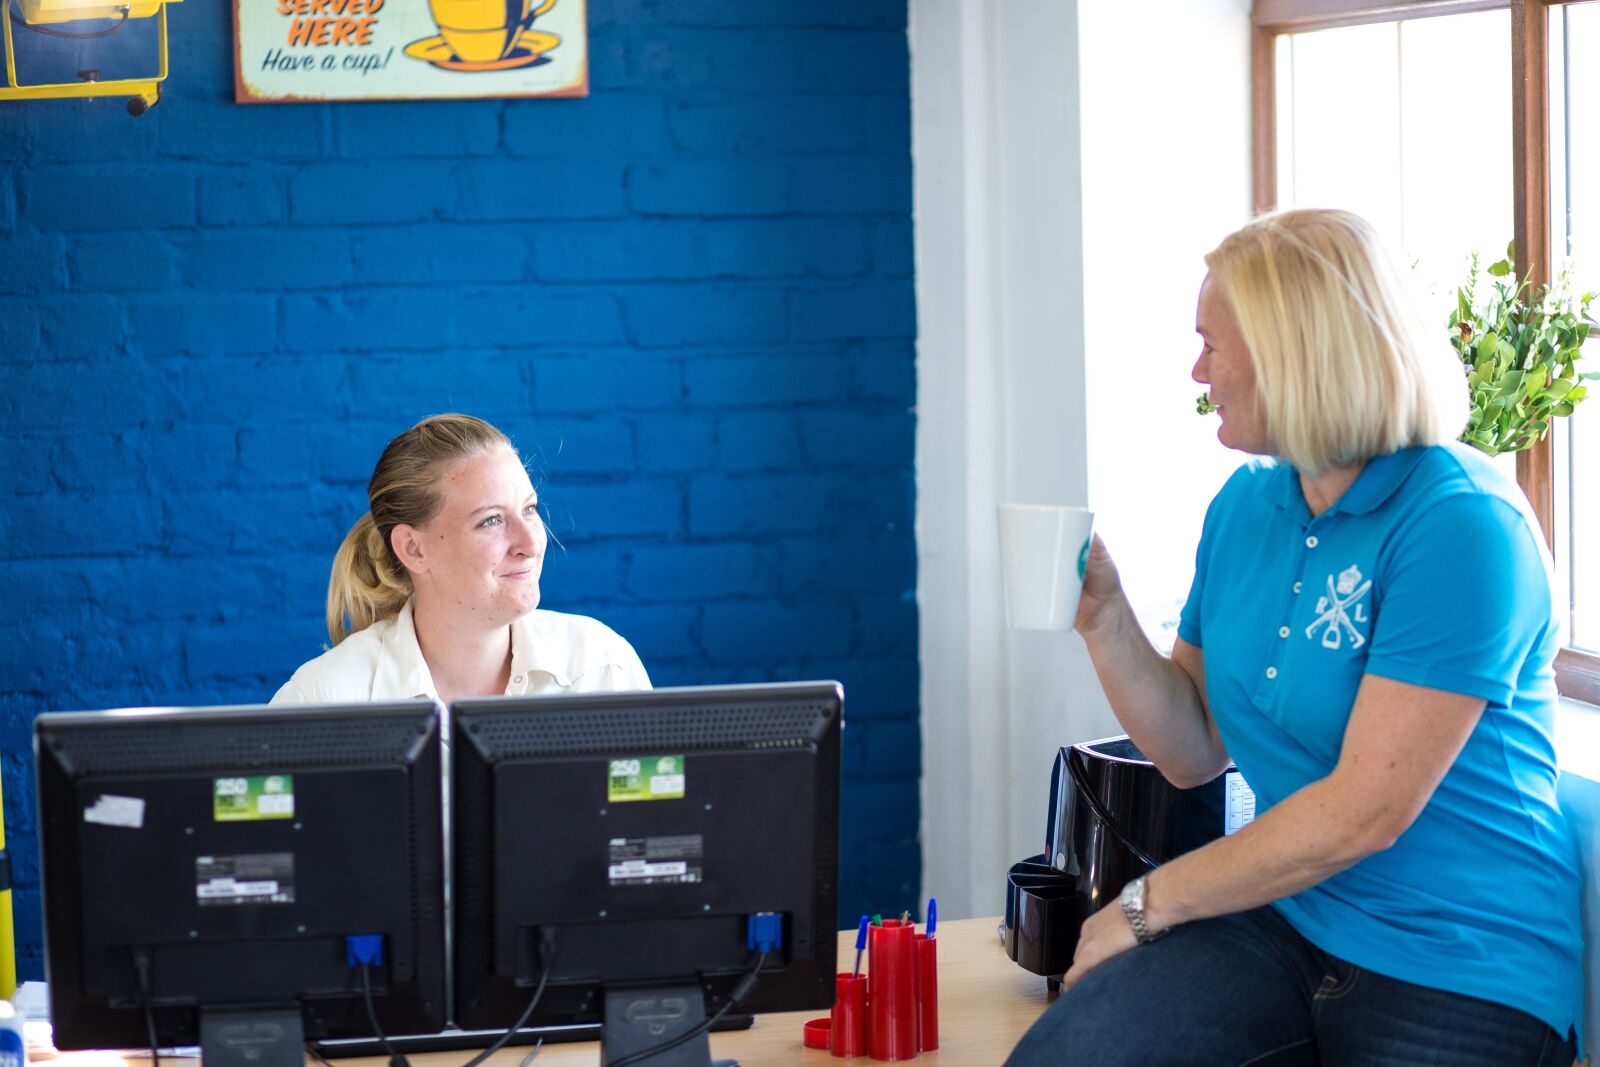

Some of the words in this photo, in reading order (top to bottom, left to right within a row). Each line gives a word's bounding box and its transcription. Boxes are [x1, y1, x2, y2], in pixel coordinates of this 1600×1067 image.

[276, 0, 385, 15] SERVED
[287, 17, 379, 46] HERE
[261, 48, 314, 71] Have
[320, 55, 336, 70] a
[342, 47, 394, 76] cup!
